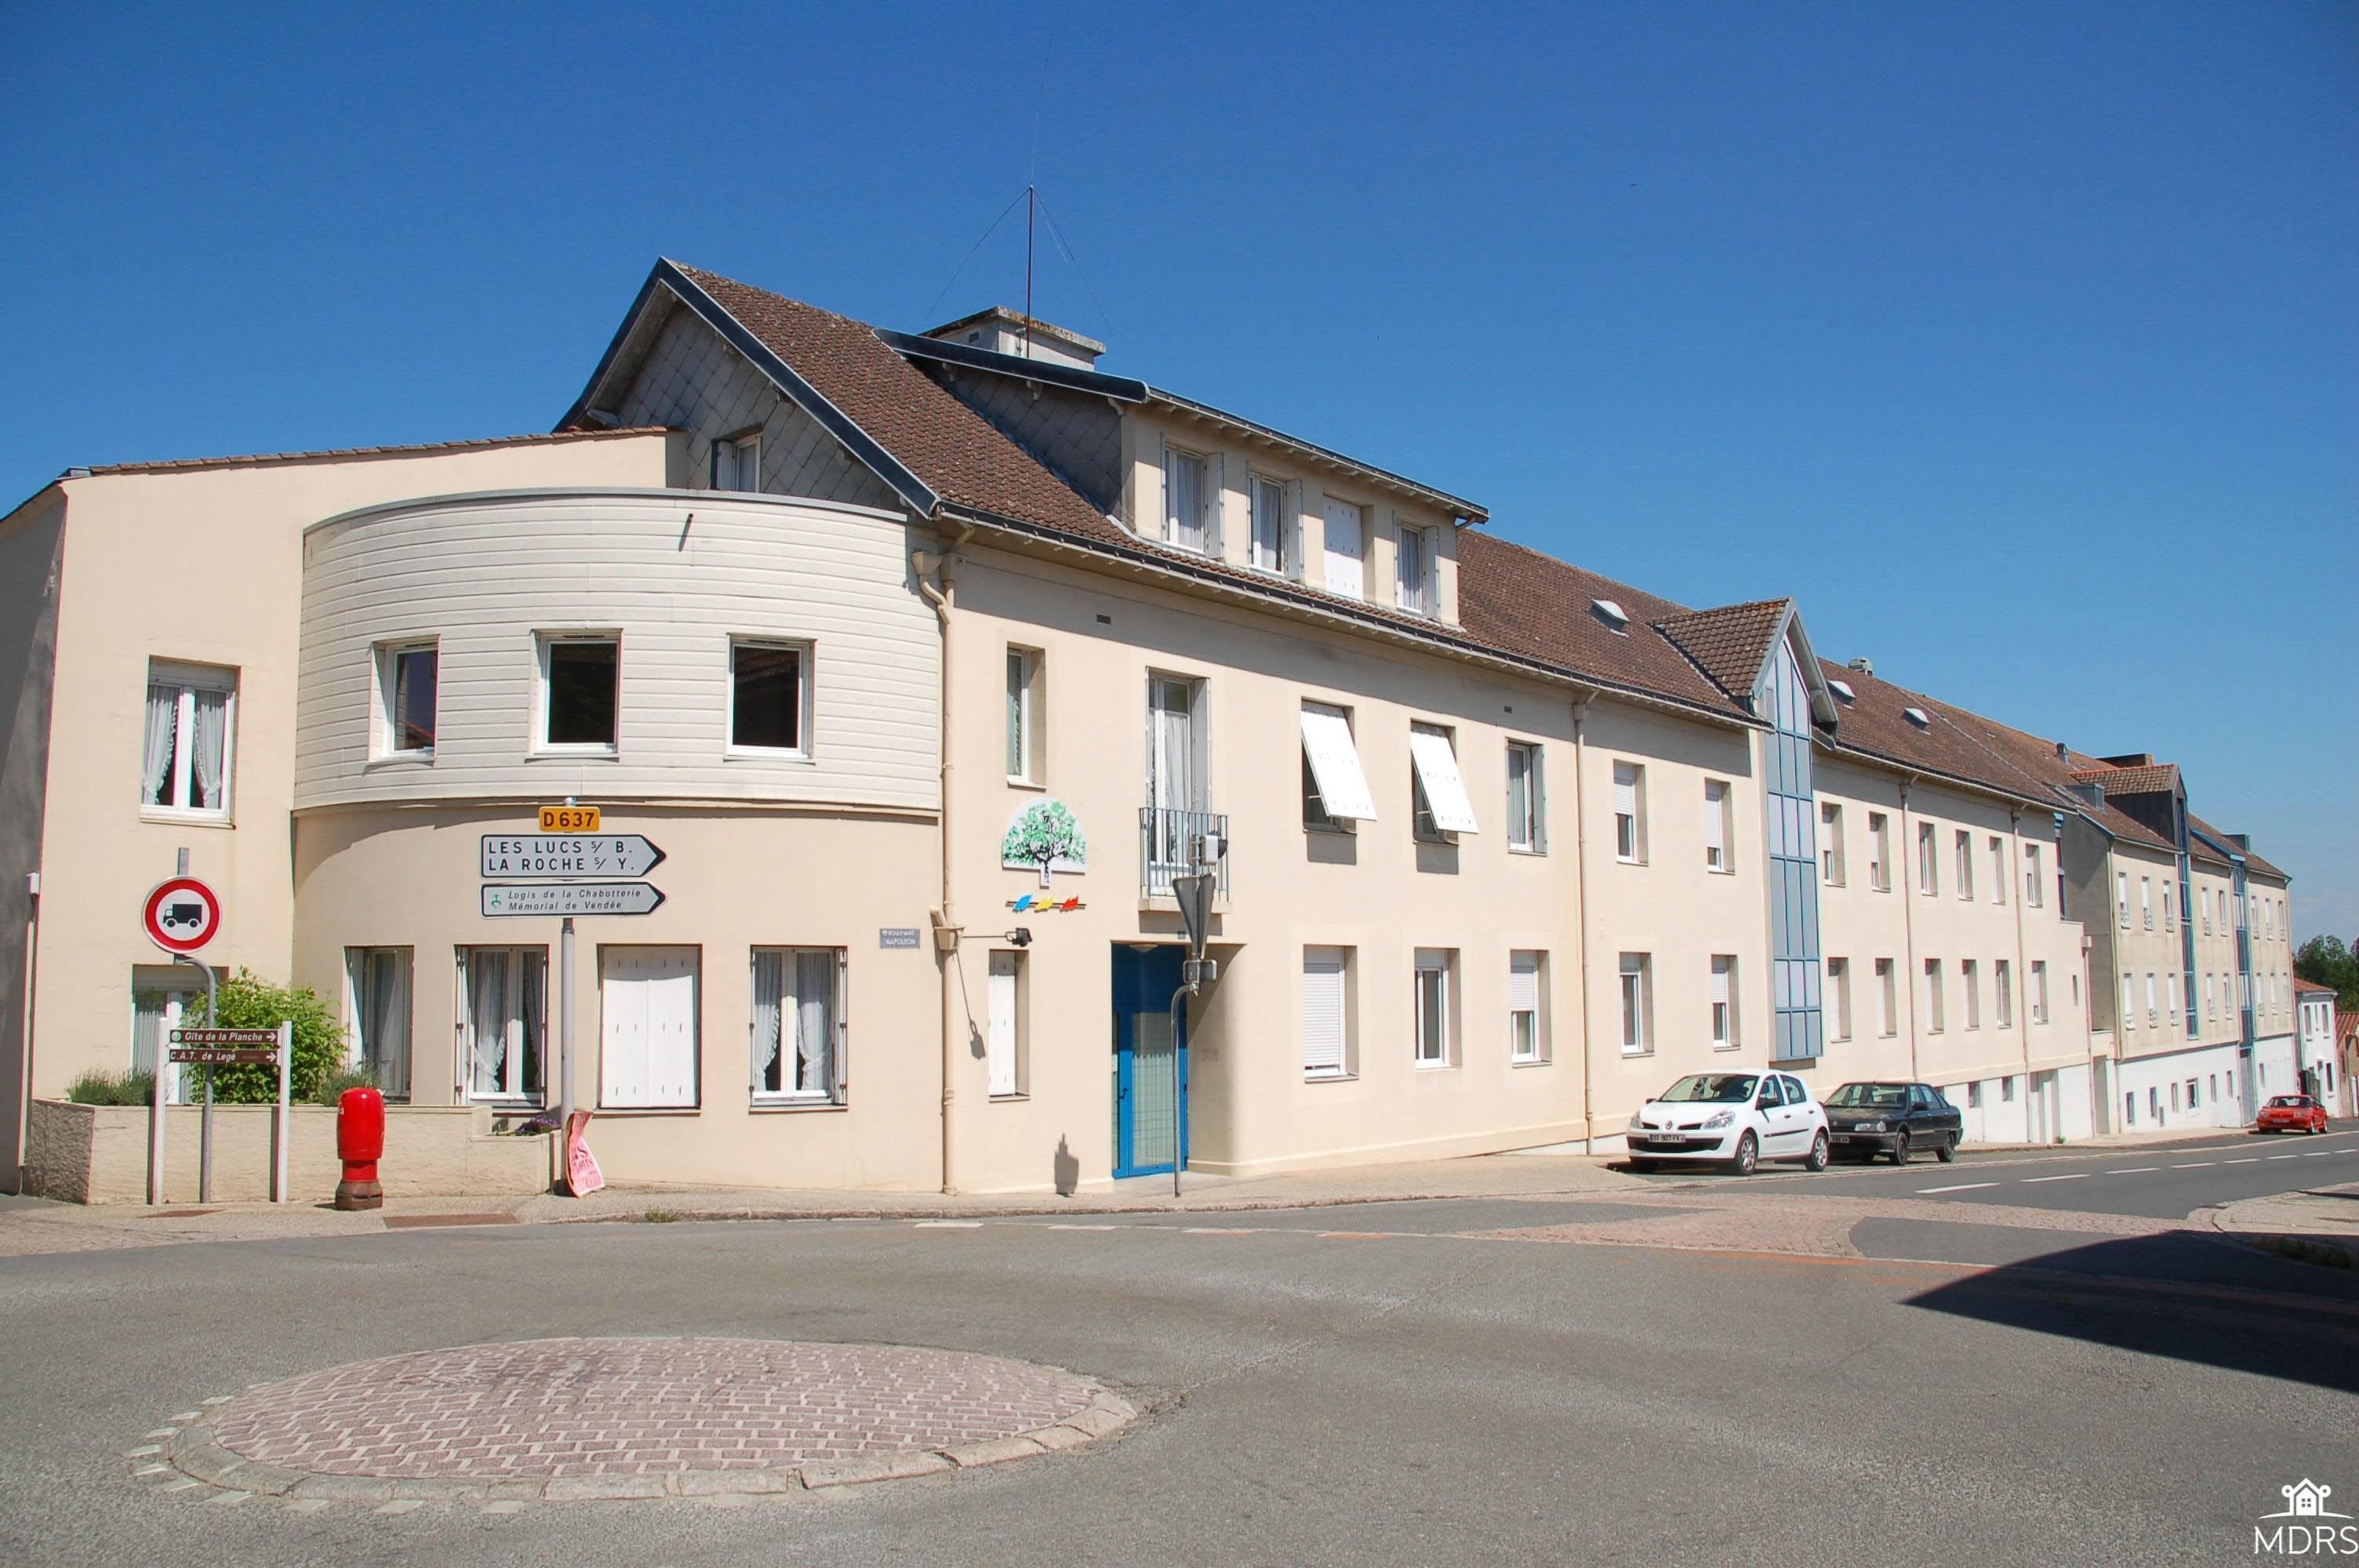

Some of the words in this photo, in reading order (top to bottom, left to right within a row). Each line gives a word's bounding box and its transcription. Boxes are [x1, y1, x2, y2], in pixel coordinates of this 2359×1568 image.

[489, 841, 522, 854] LES
[535, 840, 582, 854] LUCS
[616, 840, 632, 854] B.
[489, 858, 509, 871] LA
[522, 858, 584, 870] ROCHE
[617, 858, 634, 870] Y.
[508, 891, 536, 901] Logis
[543, 890, 555, 898] de
[579, 888, 641, 898] Chabotterie
[508, 902, 558, 910] Mémorial
[565, 901, 577, 909] de
[584, 901, 622, 909] Vendée
[205, 1032, 216, 1041] de
[219, 1032, 227, 1041] la
[229, 1031, 264, 1041] Planche
[202, 1051, 213, 1061] de
